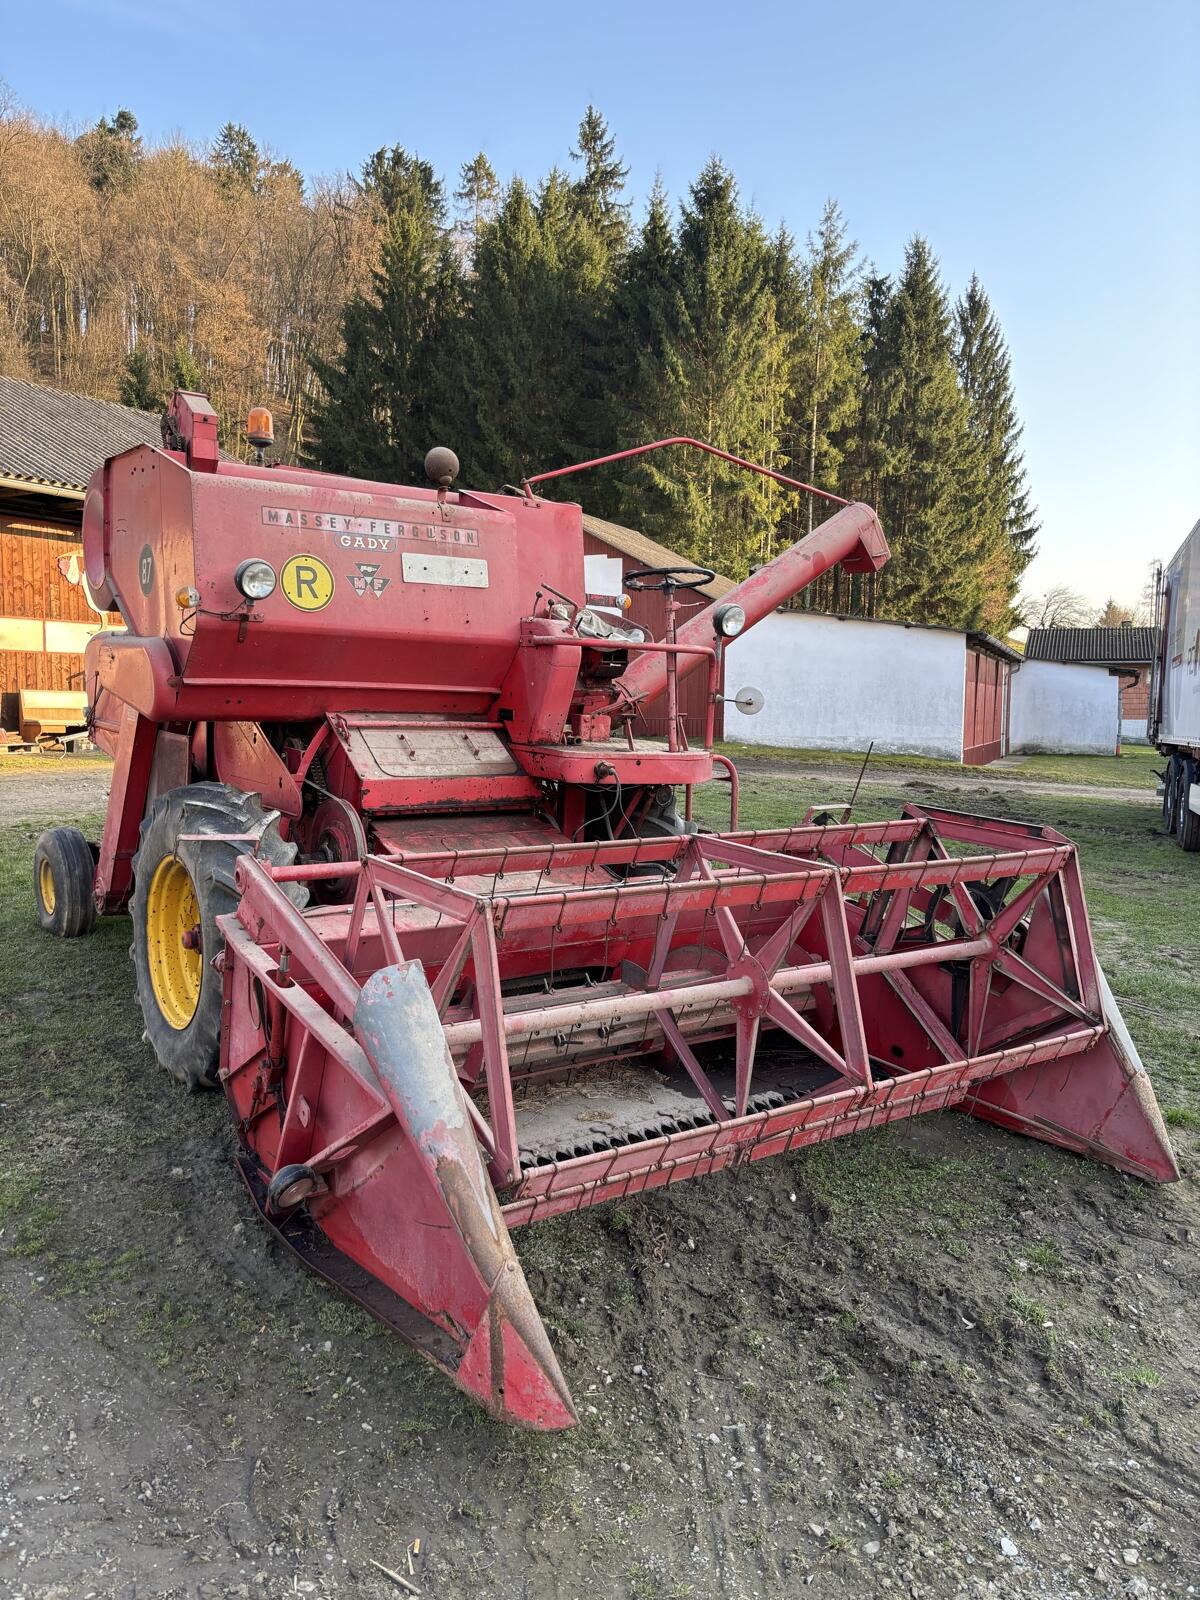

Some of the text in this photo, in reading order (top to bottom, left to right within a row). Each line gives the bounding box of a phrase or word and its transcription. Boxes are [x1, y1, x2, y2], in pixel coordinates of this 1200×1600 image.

[340, 535, 390, 550] GADY
[141, 556, 152, 585] 87
[296, 565, 319, 599] R
